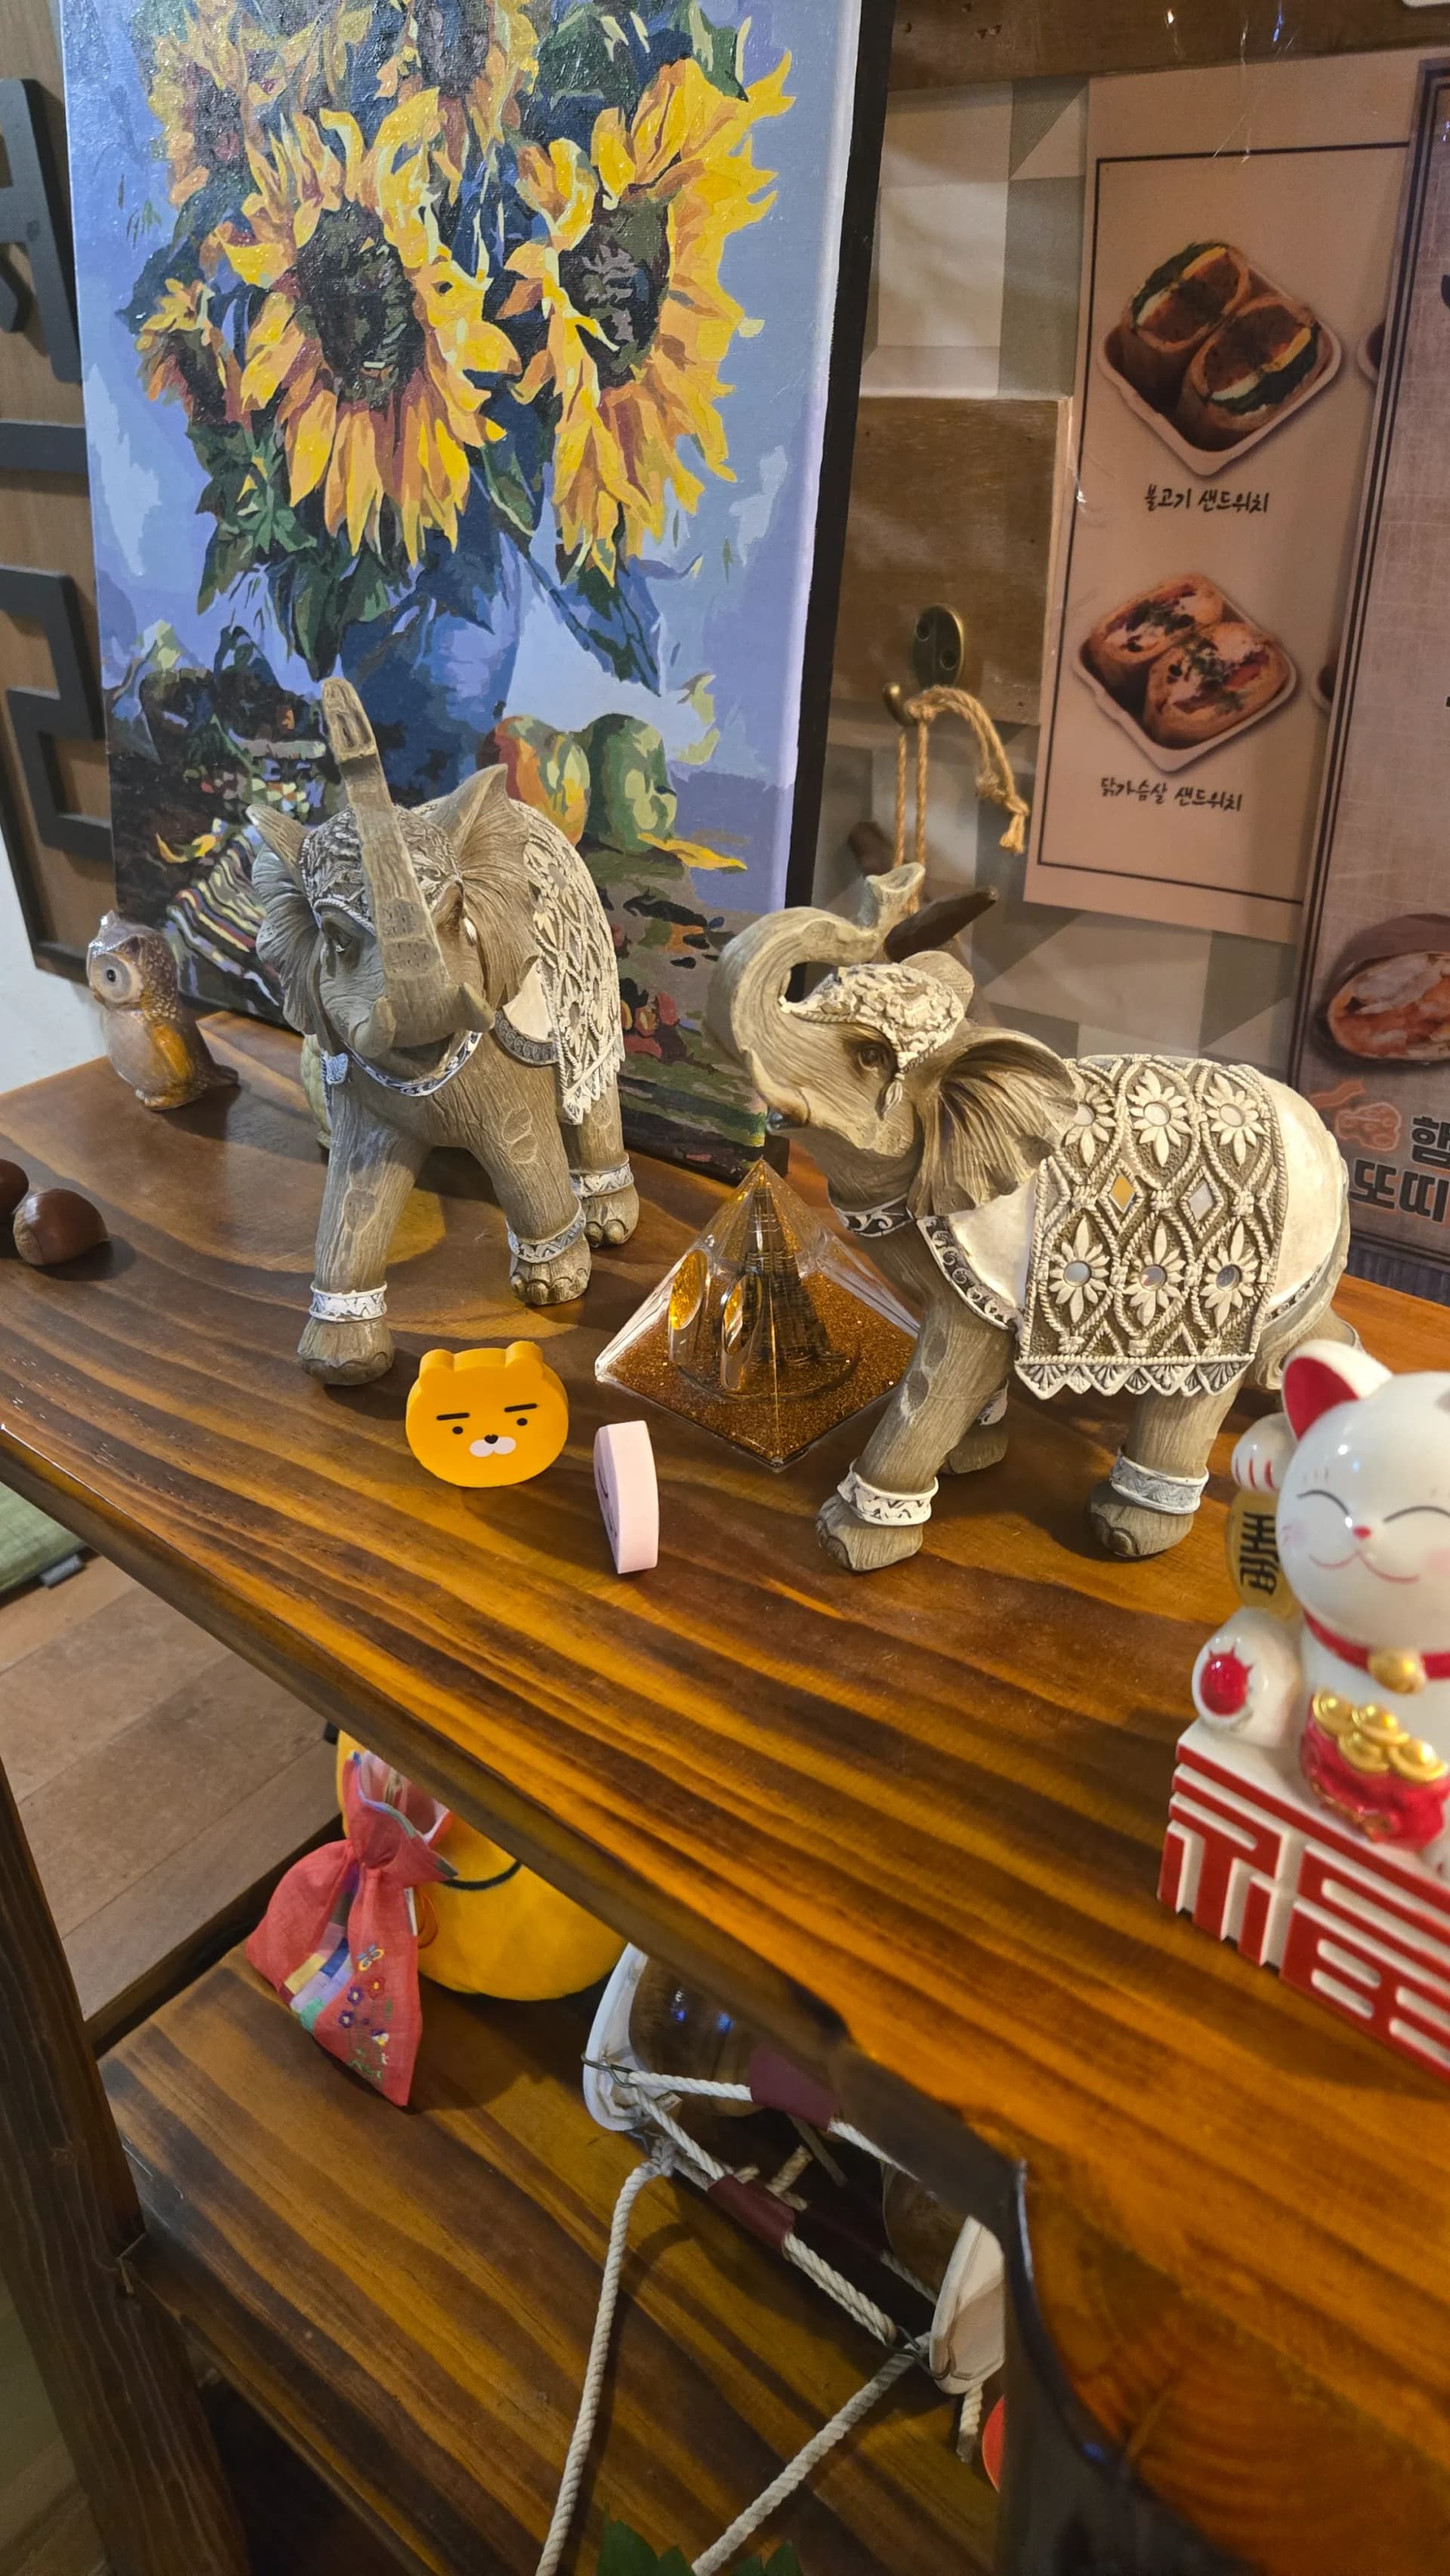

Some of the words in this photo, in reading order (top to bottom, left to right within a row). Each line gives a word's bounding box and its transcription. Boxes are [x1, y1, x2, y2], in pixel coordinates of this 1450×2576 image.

[1145, 483, 1192, 512] 불고기
[1198, 489, 1270, 514] 샌드위치
[1100, 777, 1168, 805] 닭가슴살
[1174, 786, 1242, 811] 샌드위치
